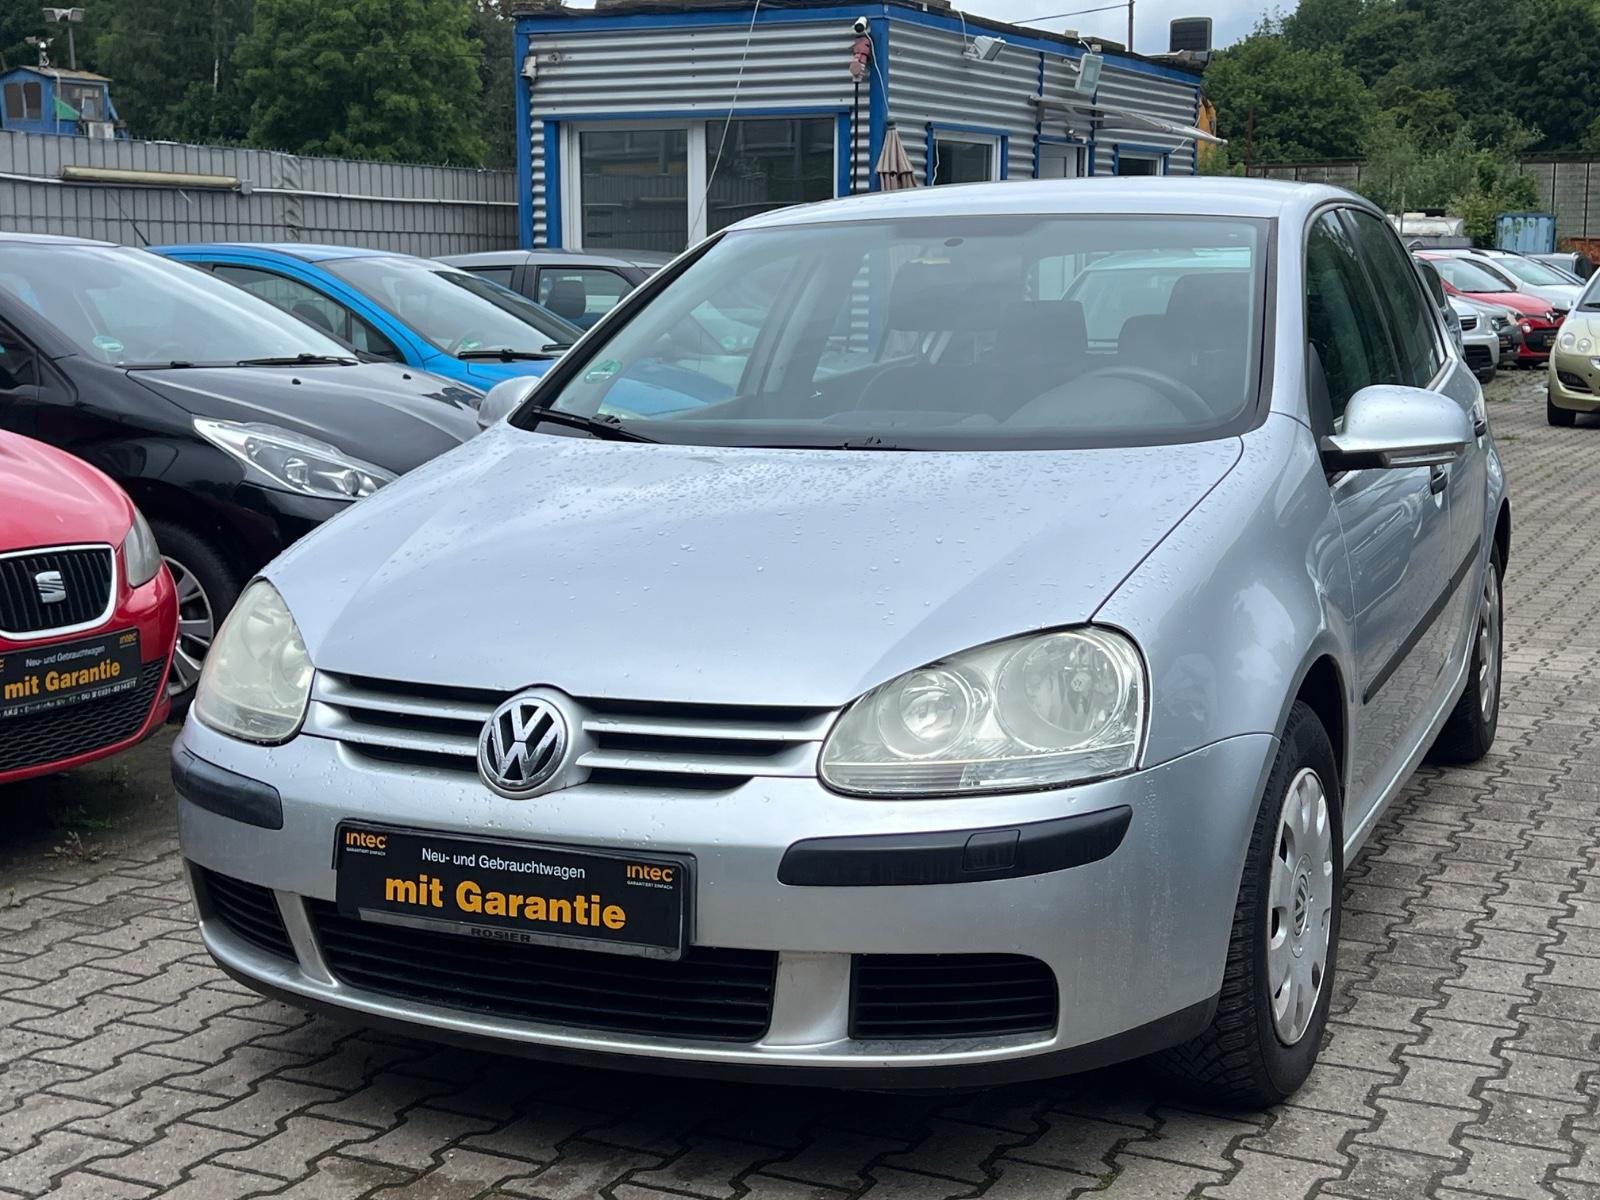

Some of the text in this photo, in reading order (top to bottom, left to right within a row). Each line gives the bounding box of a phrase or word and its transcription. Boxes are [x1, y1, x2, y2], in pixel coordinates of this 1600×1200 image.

[25, 657, 43, 668] Neu-
[43, 654, 57, 664] und
[4, 658, 121, 700] mit Garantie
[485, 699, 563, 785] VW
[345, 832, 386, 849] intec
[421, 847, 586, 880] Neu- und Gebrauchtwagen
[626, 864, 673, 882] intec
[385, 874, 627, 930] mit Garantie
[471, 927, 531, 943] ROSIER
